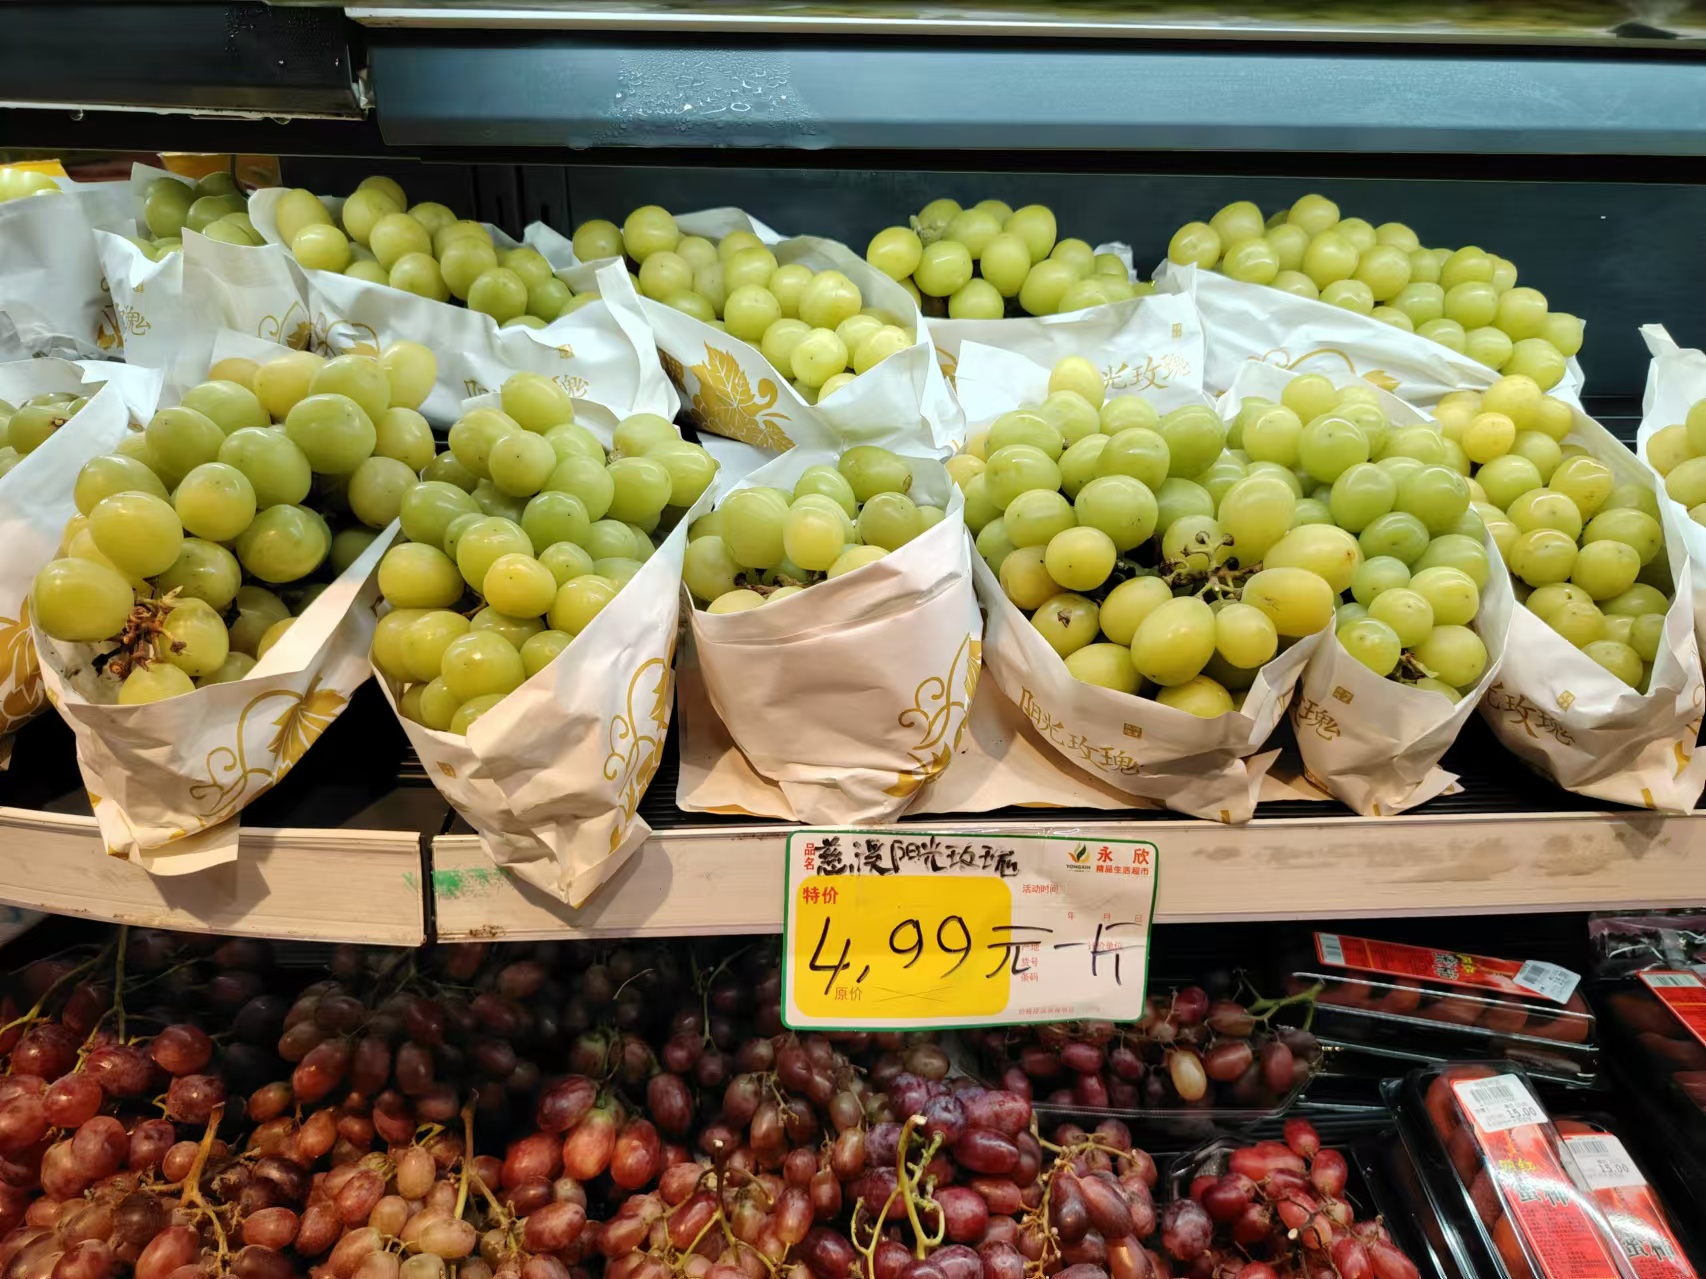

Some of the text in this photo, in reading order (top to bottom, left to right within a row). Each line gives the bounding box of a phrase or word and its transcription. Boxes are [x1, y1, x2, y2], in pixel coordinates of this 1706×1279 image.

[1018, 685, 1145, 776] 阳光玫瑰
[804, 842, 816, 870] 品名
[1096, 865, 1149, 876] 精品生活超市
[802, 886, 839, 905] 特价
[1022, 883, 1059, 894] 活动时间
[834, 986, 863, 1002] 原价
